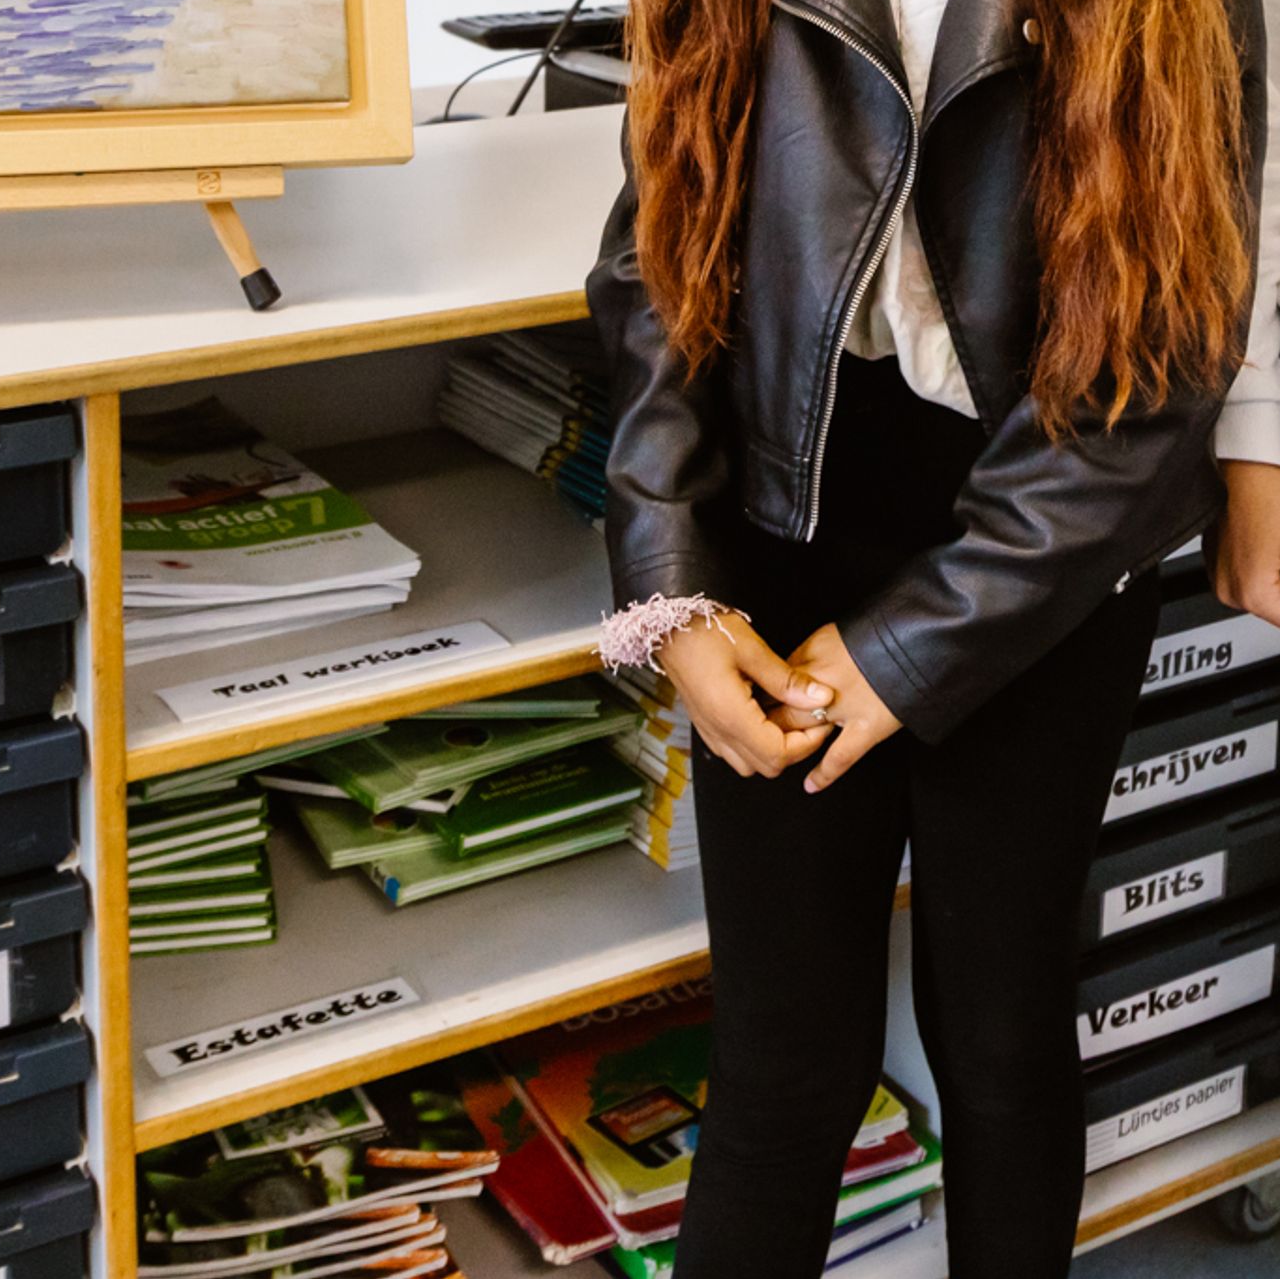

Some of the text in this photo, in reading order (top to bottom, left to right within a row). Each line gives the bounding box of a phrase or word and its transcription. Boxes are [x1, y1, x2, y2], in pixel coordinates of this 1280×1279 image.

[176, 504, 278, 531] actief
[188, 519, 295, 546] groep
[280, 496, 327, 526] 7
[212, 637, 461, 698] Taal werkboek
[1144, 640, 1232, 684] elling
[1112, 738, 1248, 797] chrijven
[1122, 870, 1205, 916] Blits
[168, 989, 403, 1068] Estafette
[1087, 976, 1219, 1036] Verkeer
[1118, 1074, 1237, 1138] Lijntjes papier
